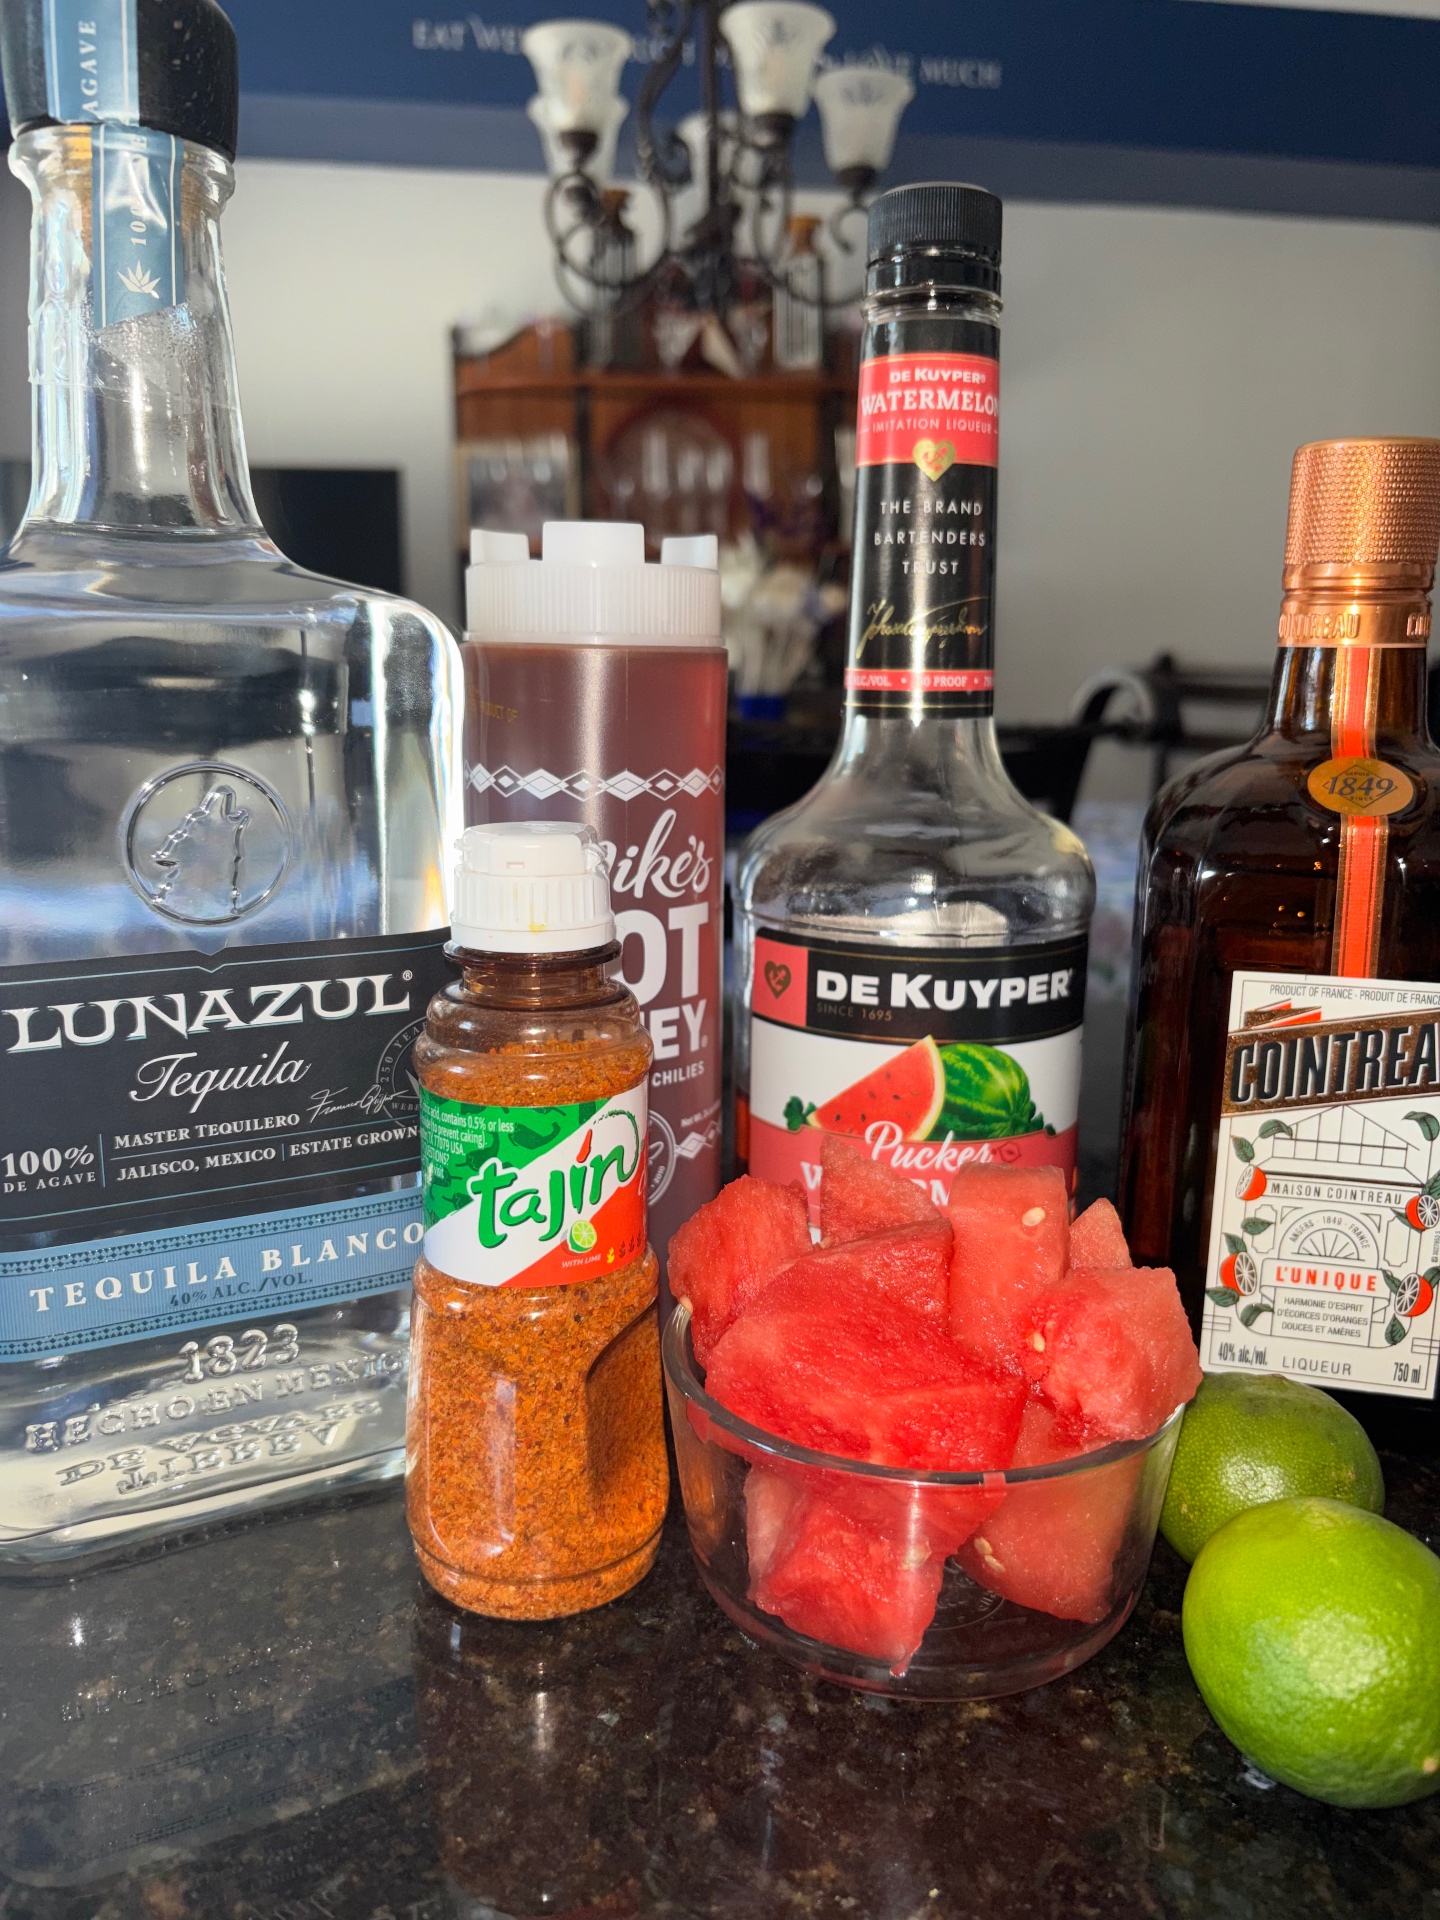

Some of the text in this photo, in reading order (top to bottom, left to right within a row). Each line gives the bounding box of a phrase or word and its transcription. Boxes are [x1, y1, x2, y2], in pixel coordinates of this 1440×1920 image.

[78, 20, 98, 116] AGAVE
[889, 369, 911, 384] DE
[872, 418, 992, 434] IMITATION LIQUEUR
[880, 501, 983, 516] THE BRAND
[874, 531, 987, 547] BARTENDERS
[902, 561, 959, 575] TRUST
[933, 675, 968, 688] PROOF
[1328, 776, 1394, 797] 1849
[600, 808, 713, 899] ike's
[612, 902, 709, 1006] OT
[816, 969, 880, 1006] DE
[1270, 984, 1306, 997] PRODUCT
[1308, 986, 1319, 997] OF
[1320, 988, 1352, 1000] FRANCE
[1359, 989, 1395, 1002] PRODUIT
[1397, 992, 1408, 1003] DE
[816, 1002, 892, 1022] SINCE 1695
[380, 1056, 394, 1083] 250
[652, 1060, 705, 1087] CHILIES
[1230, 1021, 1439, 1106] COINTREA
[128, 1041, 312, 1114] Tequila
[114, 1113, 300, 1150] MASTER TEQUILERO
[441, 1112, 467, 1128] contains
[467, 1115, 487, 1131] 0.5%
[488, 1121, 497, 1131] or
[498, 1117, 515, 1132] less
[117, 1158, 200, 1181] JALISCO,
[205, 1147, 276, 1169] MEXICO
[290, 1136, 353, 1157] ESTATE
[450, 1141, 466, 1157] USA.
[864, 1121, 993, 1171] Pucker
[1, 1145, 95, 1178] 100%
[4, 1171, 96, 1194] DE AGAVE
[1271, 1182, 1403, 1205] MAISON COINTREAU
[1322, 1215, 1343, 1226] 1849
[1348, 1223, 1371, 1249] FRANCE
[29, 1221, 425, 1313] TEQUILA BLANCO
[561, 1253, 602, 1269] WITH LIME
[170, 1271, 314, 1307] 40% ALC./VOL.
[1275, 1266, 1377, 1291] L'UNIQUE
[1277, 1308, 1368, 1326] D'ÉCORCES D'ORANGES
[1284, 1297, 1364, 1312] HARMONIE D'ESPRIT
[1281, 1321, 1313, 1333] DOUCES
[1315, 1325, 1326, 1334] ET
[179, 1323, 300, 1384] 1823
[1218, 1341, 1422, 1384] 40% alc./vol. LIQUEUR 750 ml
[25, 1394, 196, 1453] HECHO
[203, 1377, 264, 1416] EN
